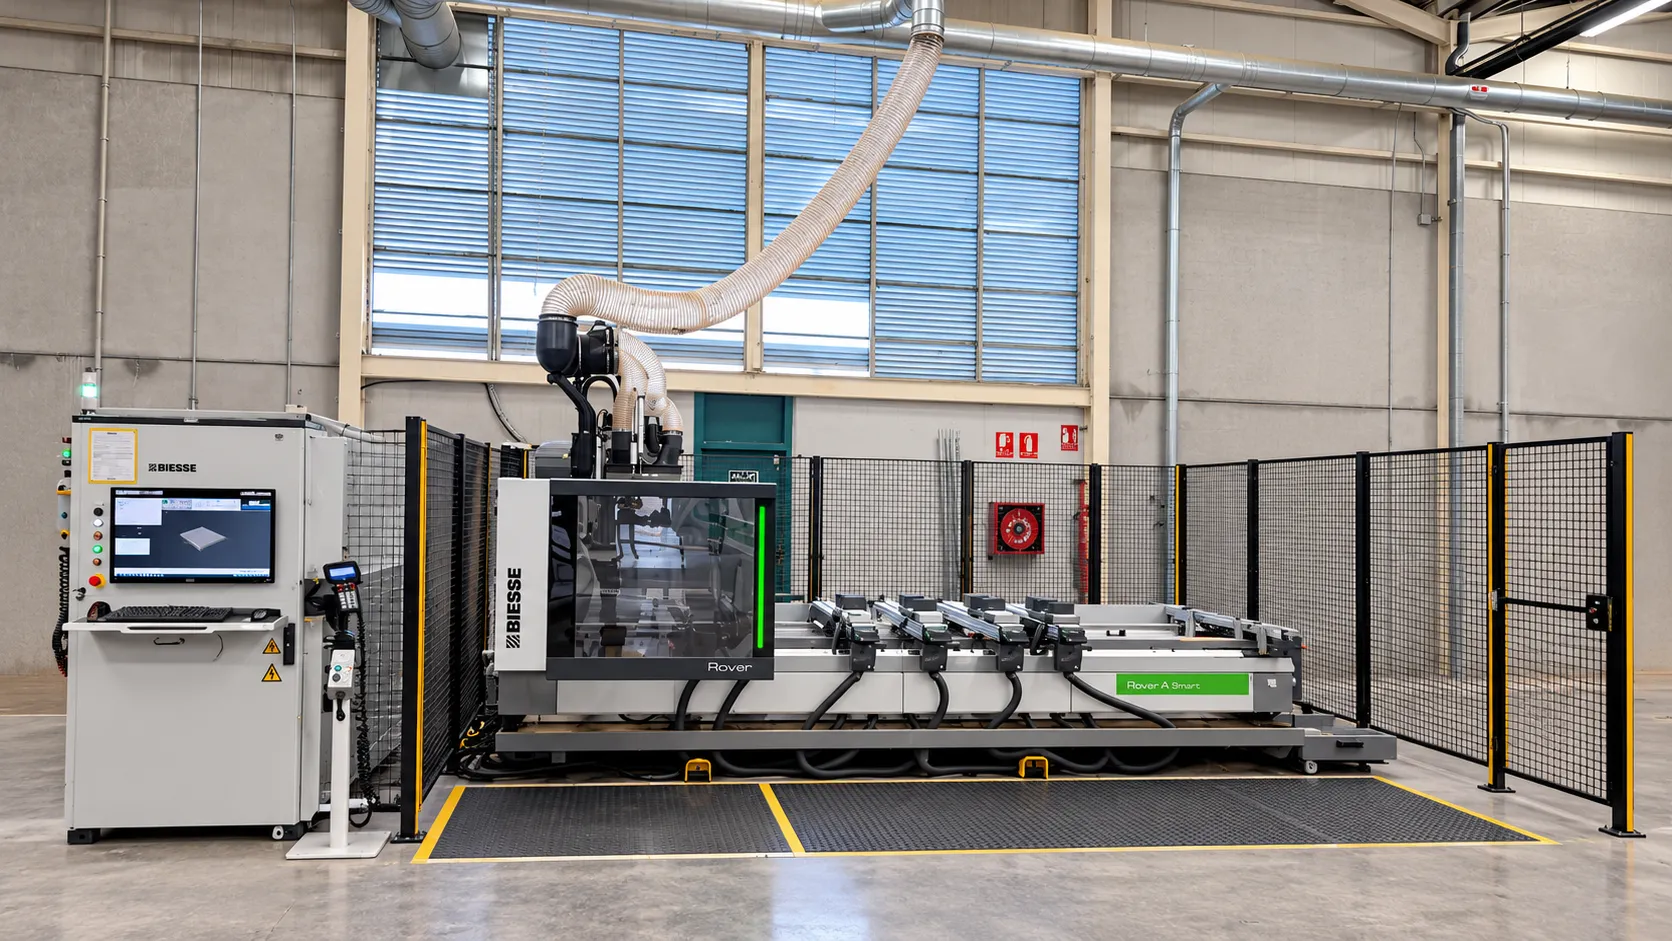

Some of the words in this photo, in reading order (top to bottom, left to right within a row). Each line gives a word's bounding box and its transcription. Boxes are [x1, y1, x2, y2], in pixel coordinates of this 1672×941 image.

[158, 463, 197, 473] BIESSE
[506, 567, 522, 633] BIESSE
[707, 662, 753, 673] Rover
[1126, 680, 1159, 690] Rover
[1160, 681, 1170, 690] A
[1171, 681, 1201, 690] Smart
